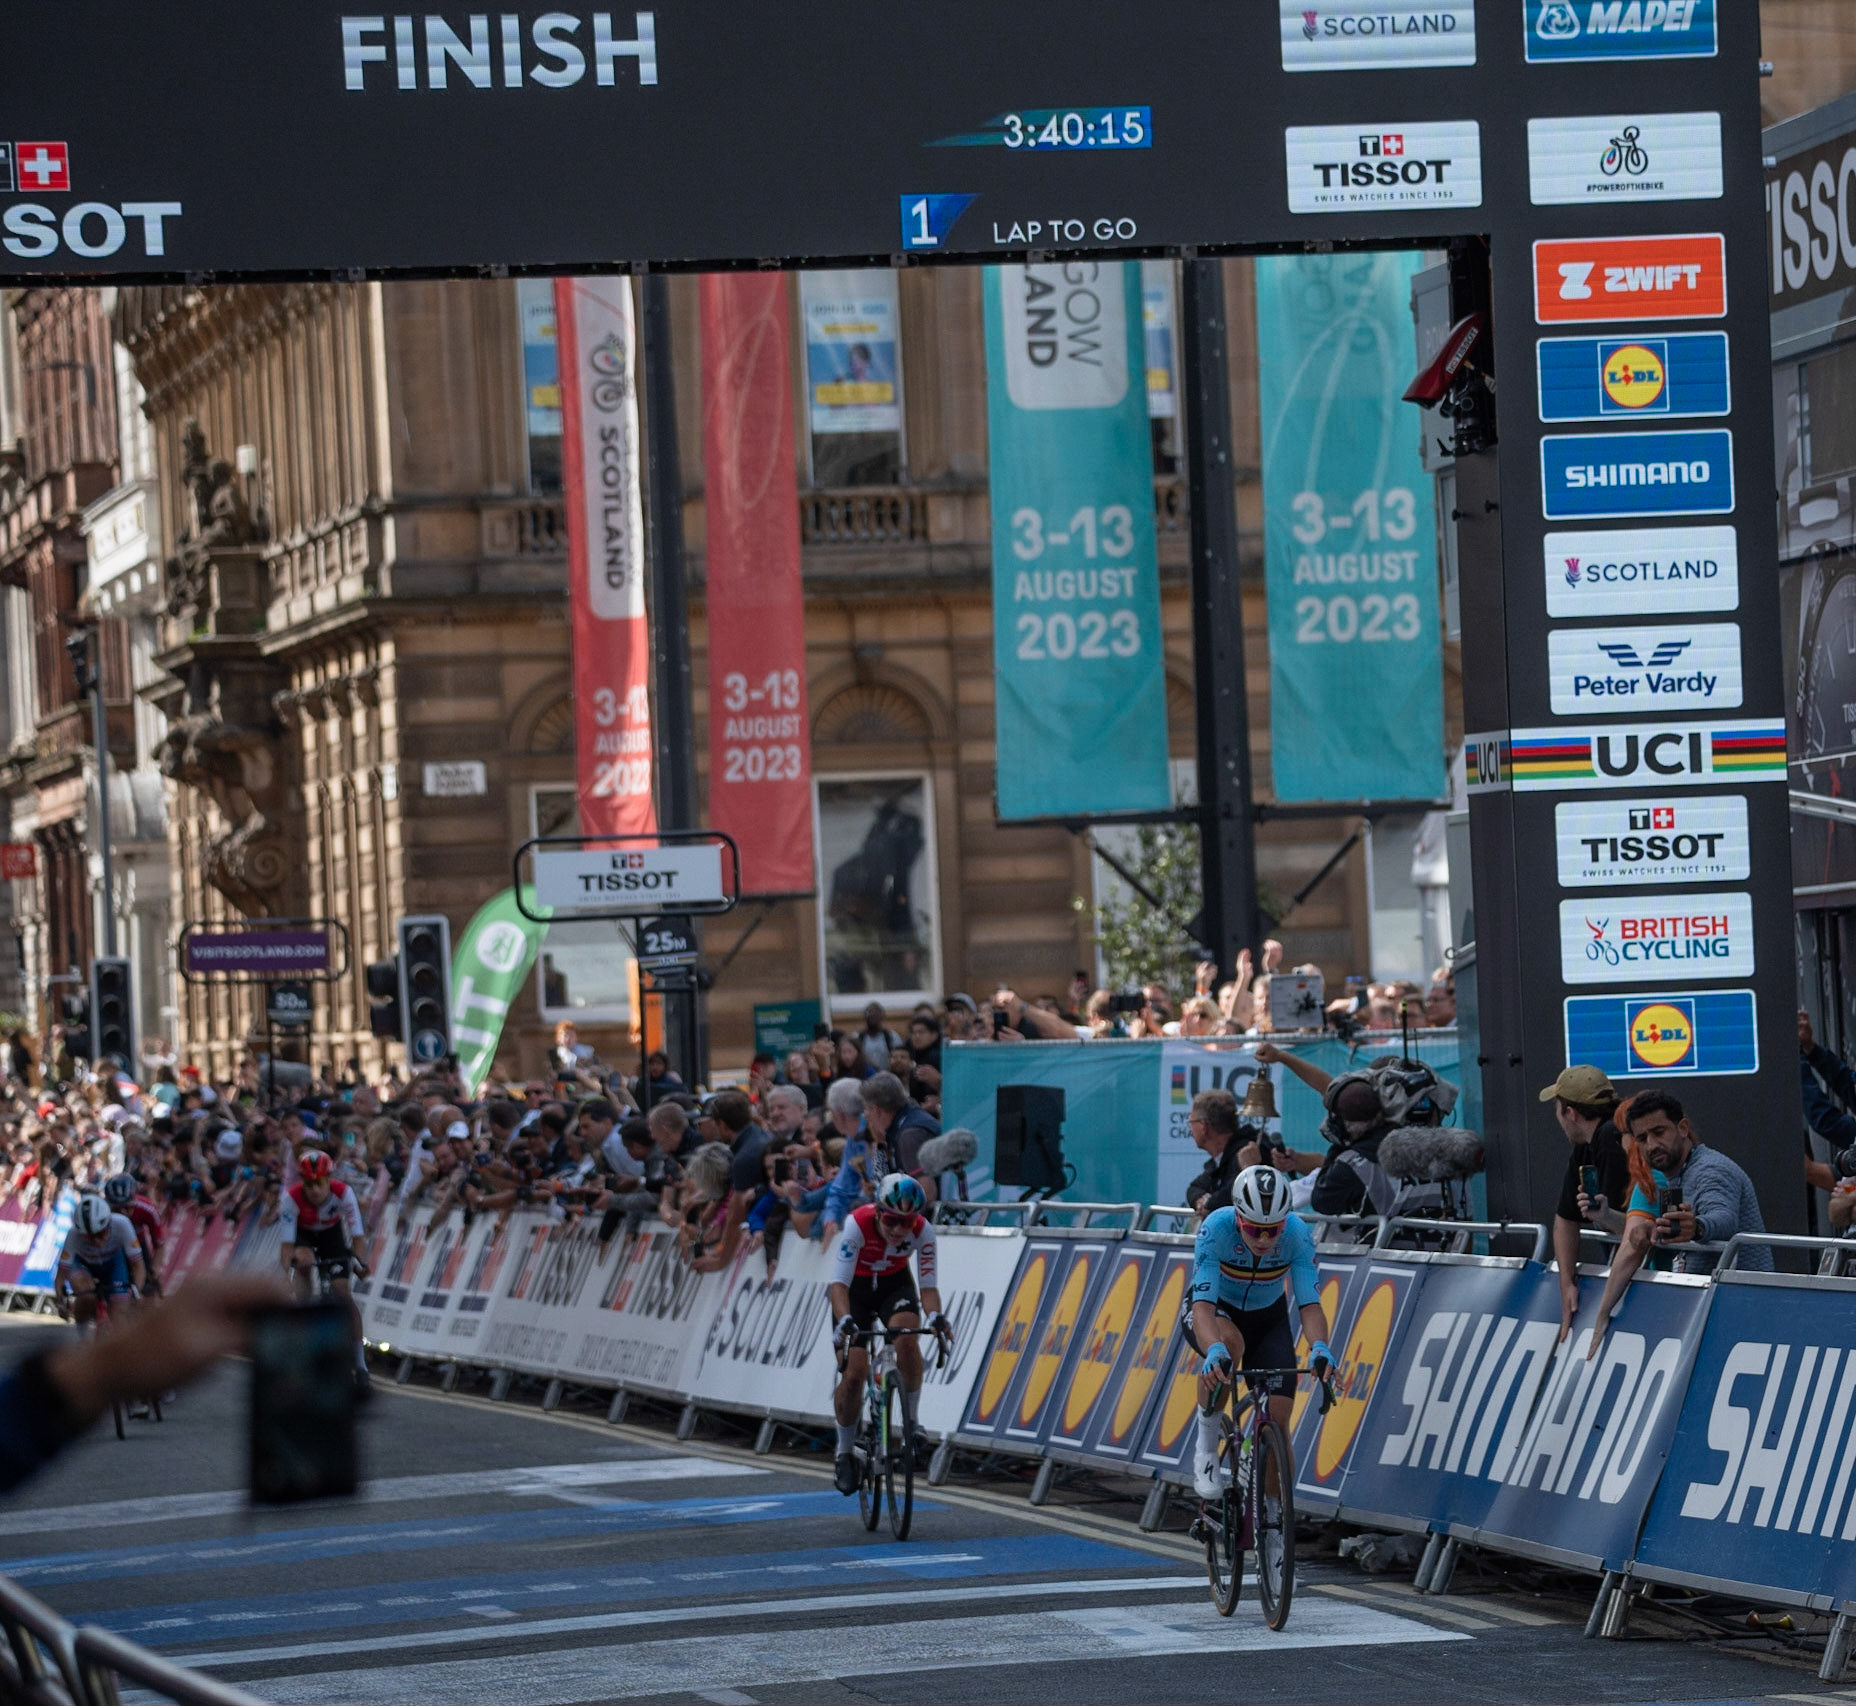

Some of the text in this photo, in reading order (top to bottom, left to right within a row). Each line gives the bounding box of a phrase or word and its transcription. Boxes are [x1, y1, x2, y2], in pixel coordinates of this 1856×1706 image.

[1324, 14, 1456, 36] SCOTLAND
[1586, 0, 1696, 34] MAPEI
[341, 12, 658, 91] FINISH
[1003, 111, 1145, 148] 3:40:15
[1313, 160, 1452, 188] TISSOT
[1586, 182, 1665, 192] #POWEROFTHEBIKE
[1314, 194, 1345, 203] SWISS
[1350, 193, 1395, 202] WATCHES
[1400, 191, 1428, 200] SINCE
[911, 198, 938, 245] 1
[993, 217, 1137, 243] LAP TO GO
[1766, 147, 1856, 295] ISSO
[1604, 264, 1701, 293] ZWIFT
[1024, 262, 1058, 368] AND
[1565, 460, 1710, 488] SHIMANO
[600, 424, 625, 590] SCOTLAND
[1292, 487, 1416, 545] 3-13
[1011, 504, 1135, 561] 3-13
[1014, 567, 1138, 602] AUGUST
[1294, 551, 1419, 585] AUGUST
[1586, 559, 1718, 583] SCOTLAND
[1016, 608, 1141, 660] 2023
[1295, 593, 1422, 644] 2023
[724, 671, 800, 711] 3-13
[1574, 672, 1717, 698] Peter Vardy
[724, 715, 801, 740] AUGUST
[724, 744, 801, 783] 2023
[1476, 741, 1500, 784] UCI
[1597, 732, 1702, 777] UCI
[1581, 833, 1724, 862] TISSOT
[578, 871, 679, 892] TISSOT
[1582, 869, 1614, 878] SWISS
[1619, 867, 1665, 876] WATCHES
[1671, 866, 1699, 874] SINCE
[1620, 914, 1729, 940] BRITISH
[1621, 938, 1730, 961] CYCLING
[1379, 1311, 1682, 1504] SHIMANO
